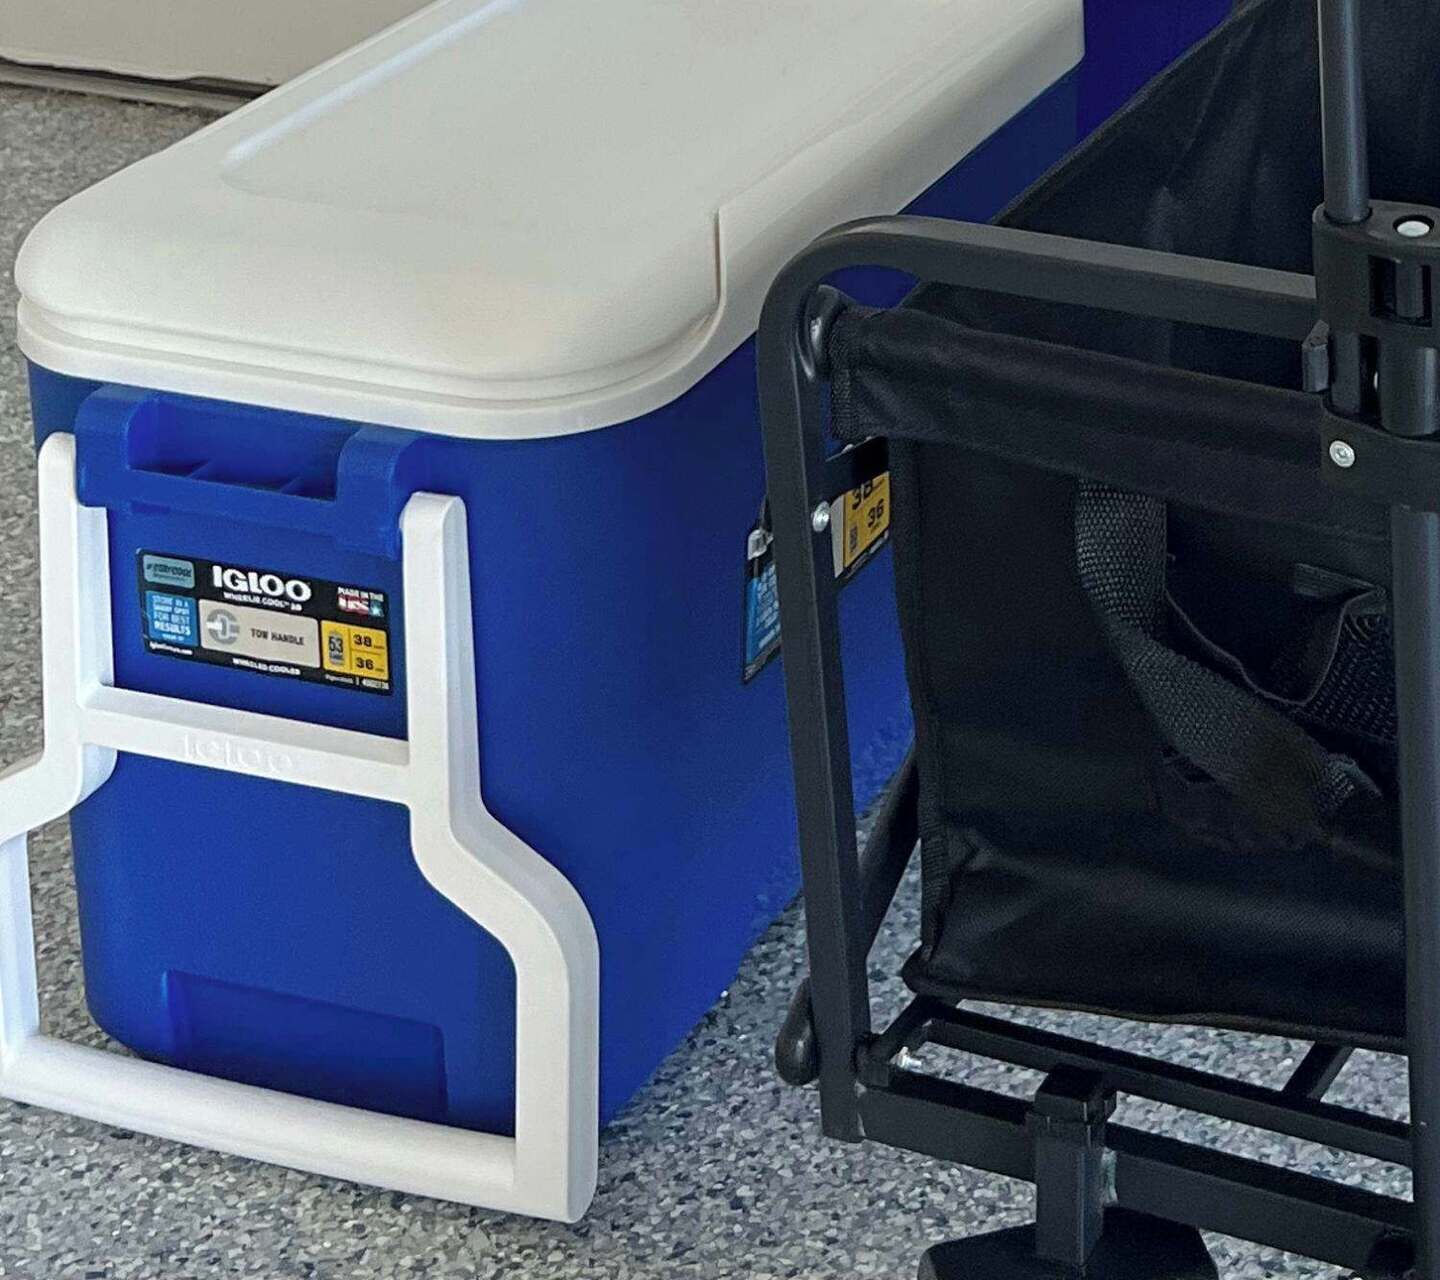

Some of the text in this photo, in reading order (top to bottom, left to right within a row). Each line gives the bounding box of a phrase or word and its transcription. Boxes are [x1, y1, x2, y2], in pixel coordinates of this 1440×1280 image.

[212, 565, 312, 602] IGLOO
[154, 621, 191, 636] RESULTS
[250, 628, 304, 646] TOW HANDLE
[328, 634, 372, 654] 53 38
[356, 657, 374, 671] 36
